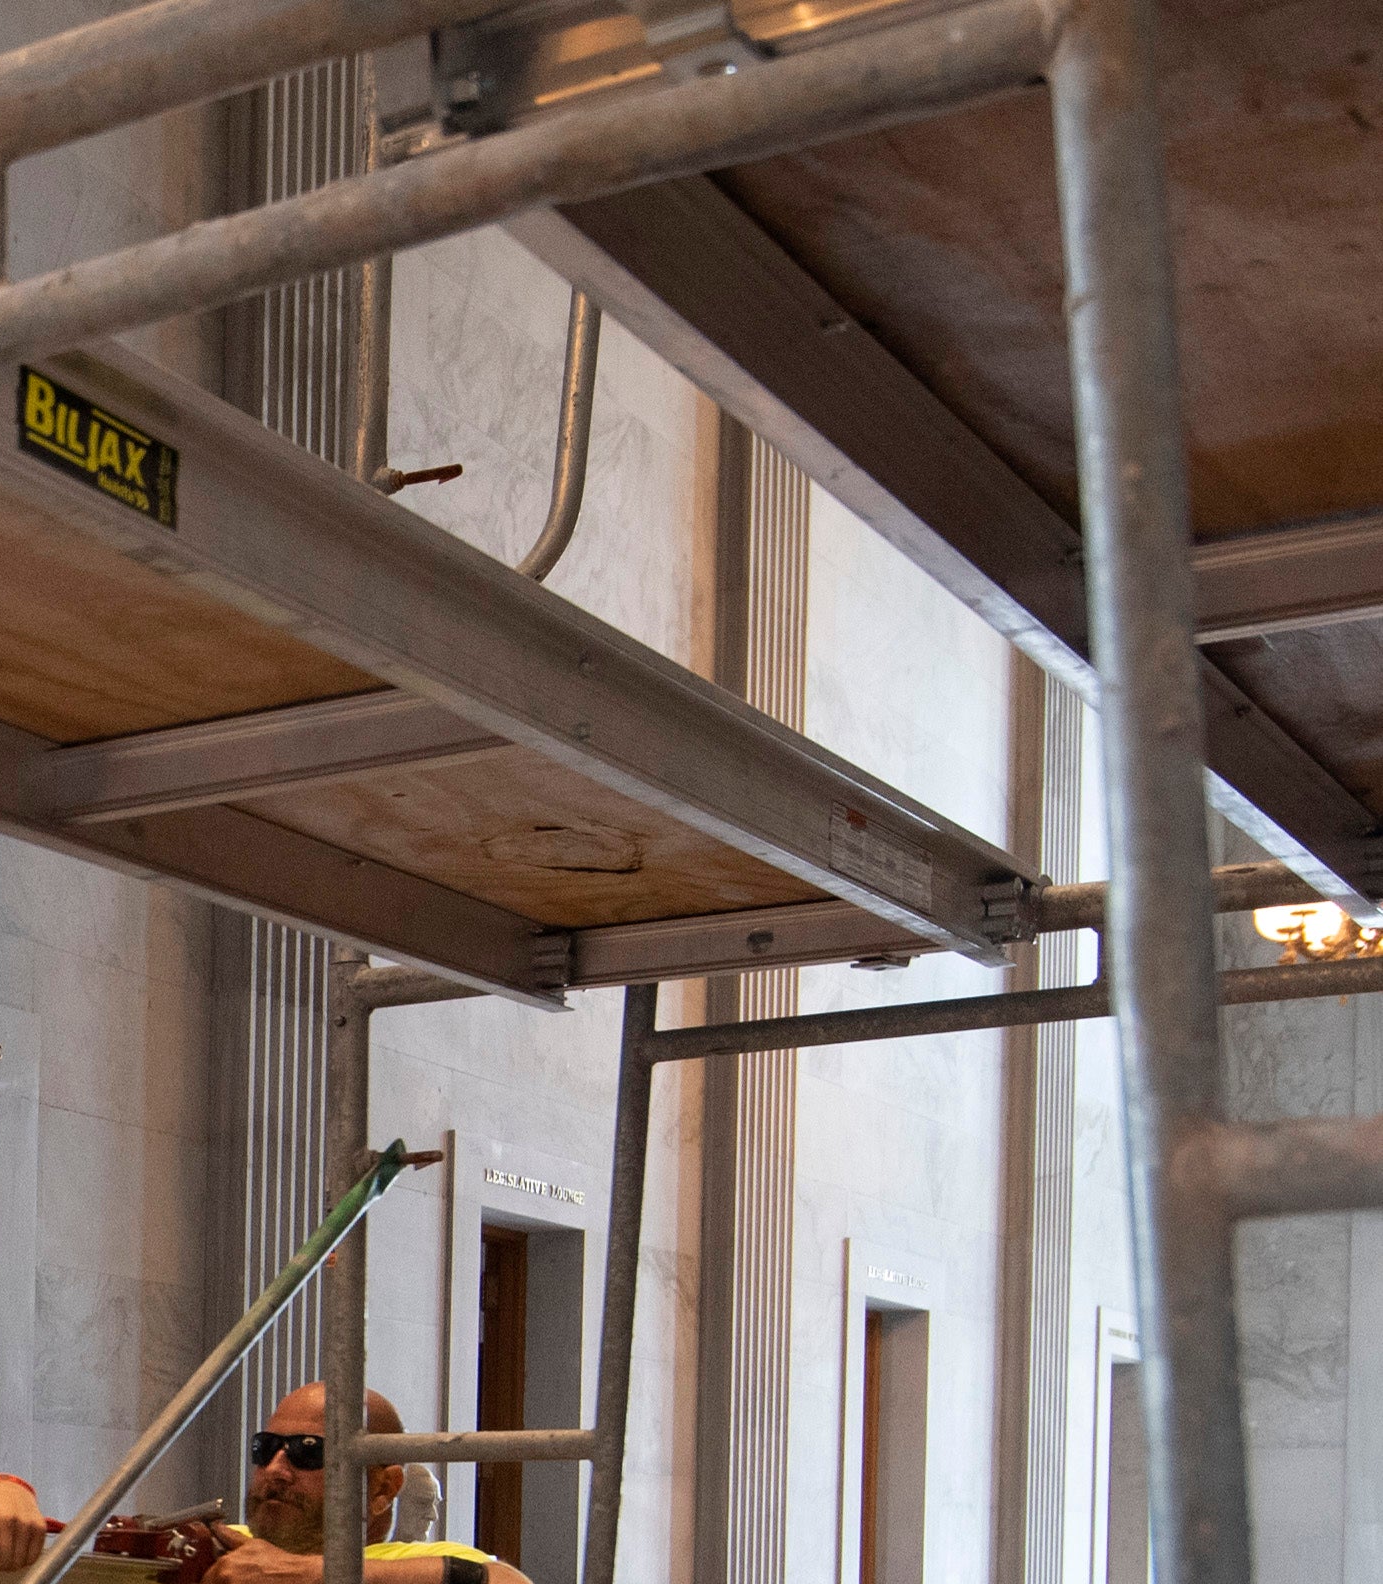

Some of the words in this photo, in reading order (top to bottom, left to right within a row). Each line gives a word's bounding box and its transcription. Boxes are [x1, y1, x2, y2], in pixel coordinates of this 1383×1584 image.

[24, 373, 146, 487] BILJAX
[484, 1168, 548, 1196] LEGISLATIVE
[550, 1184, 585, 1205] LOUNGE
